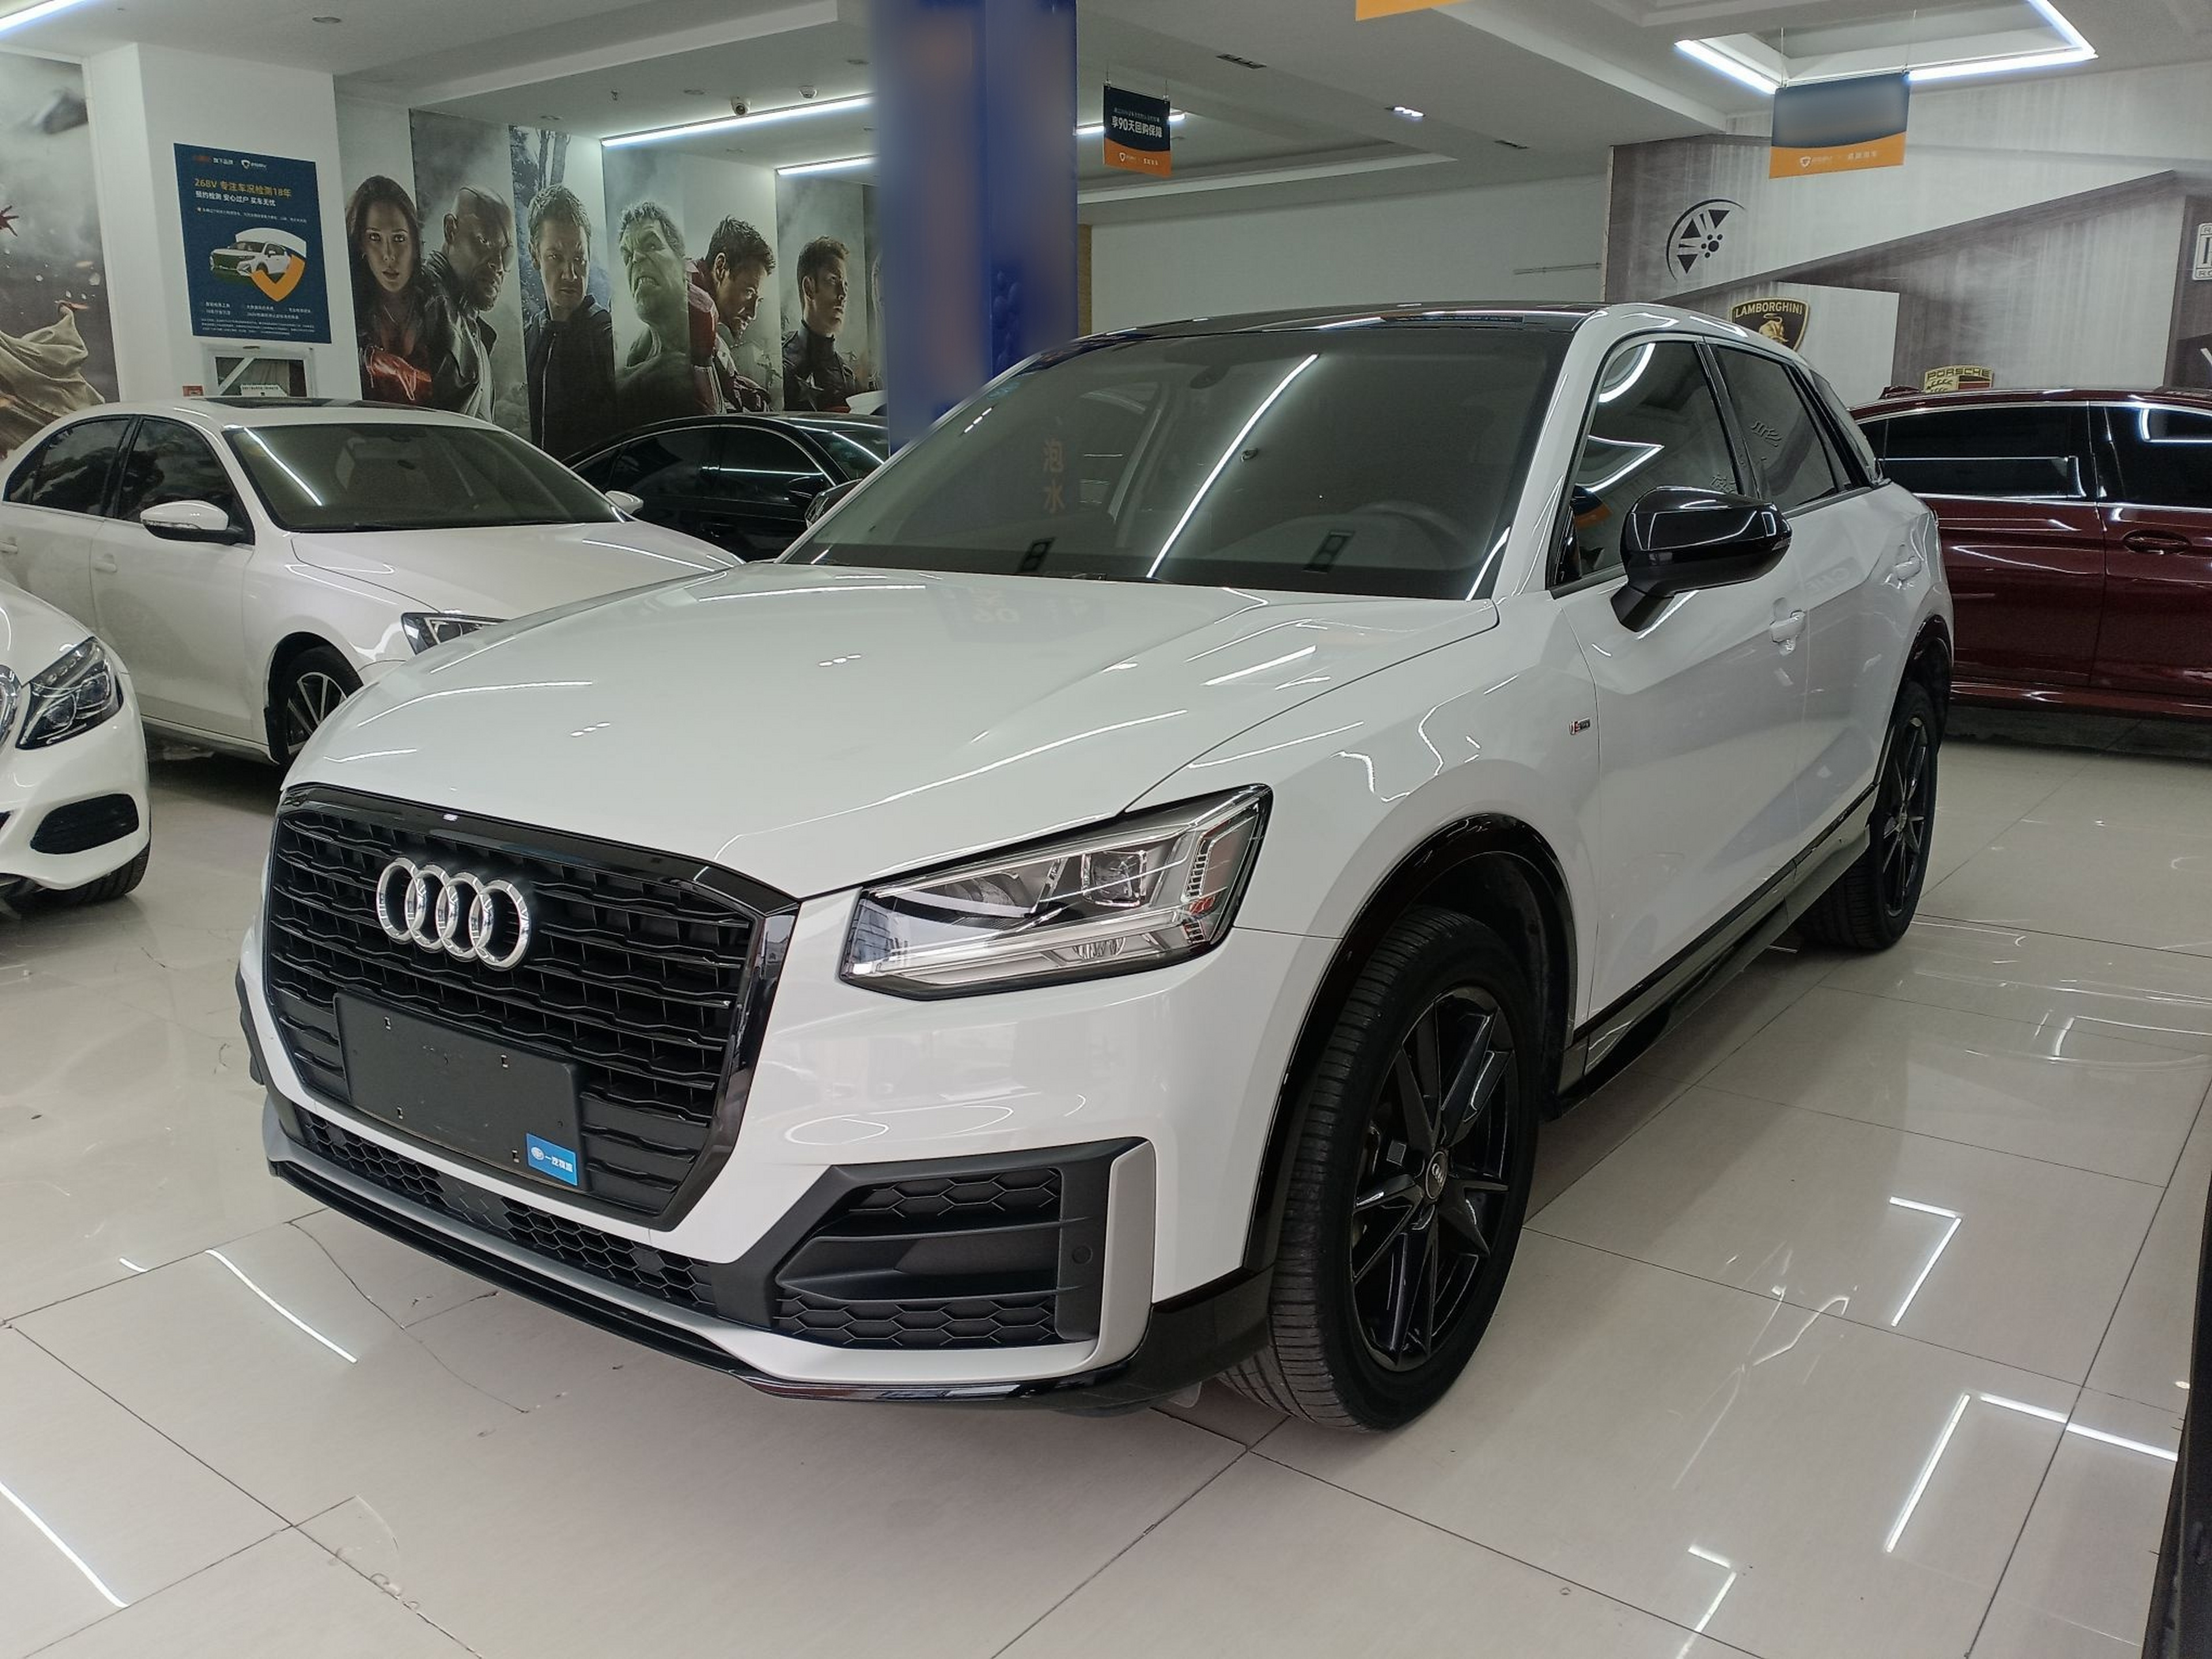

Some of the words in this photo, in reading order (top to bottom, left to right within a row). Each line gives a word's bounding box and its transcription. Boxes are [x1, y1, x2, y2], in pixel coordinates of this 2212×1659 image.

[1111, 116, 1163, 138] 享90天回购保障
[194, 178, 217, 188] 268V
[220, 180, 293, 198] 专注车况检测18年
[223, 194, 249, 203] 安心过户
[1736, 302, 1803, 318] LAMBORGHINI
[1927, 368, 1991, 380] PORSCHE
